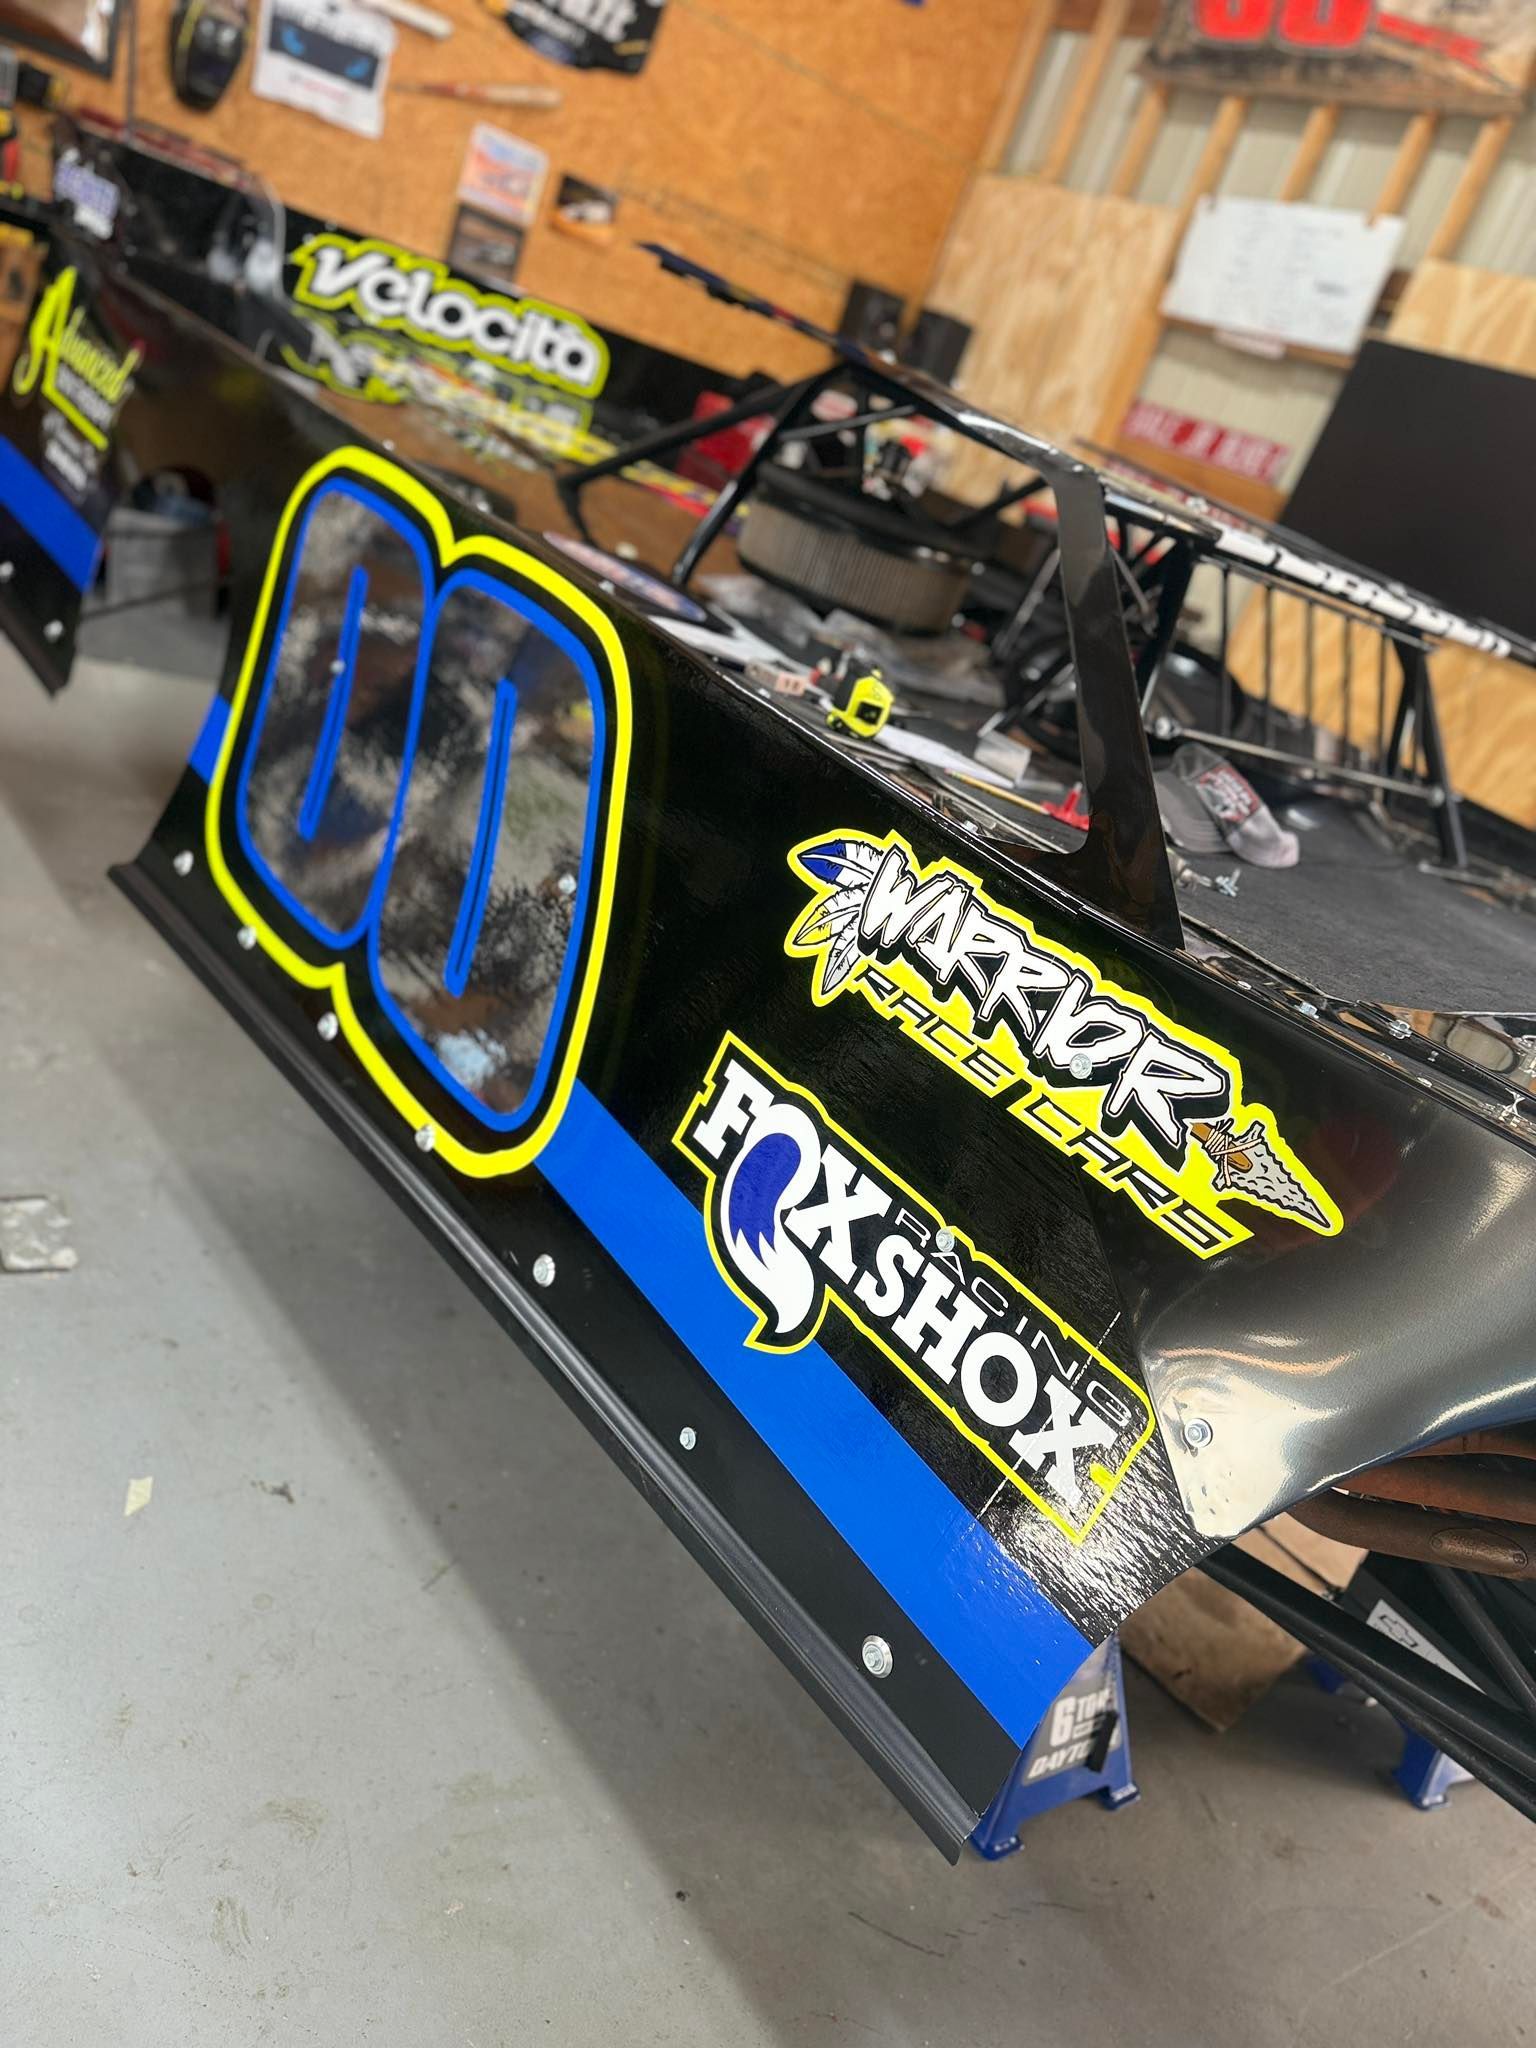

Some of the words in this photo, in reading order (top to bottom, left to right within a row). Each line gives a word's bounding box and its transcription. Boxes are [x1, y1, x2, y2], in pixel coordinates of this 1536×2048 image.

[854, 964, 1016, 1088] RACE
[1023, 1093, 1234, 1251] CARS
[857, 843, 1231, 1172] WARRIOR
[895, 1207, 1132, 1427] RACING
[1049, 1695, 1076, 1747] 6
